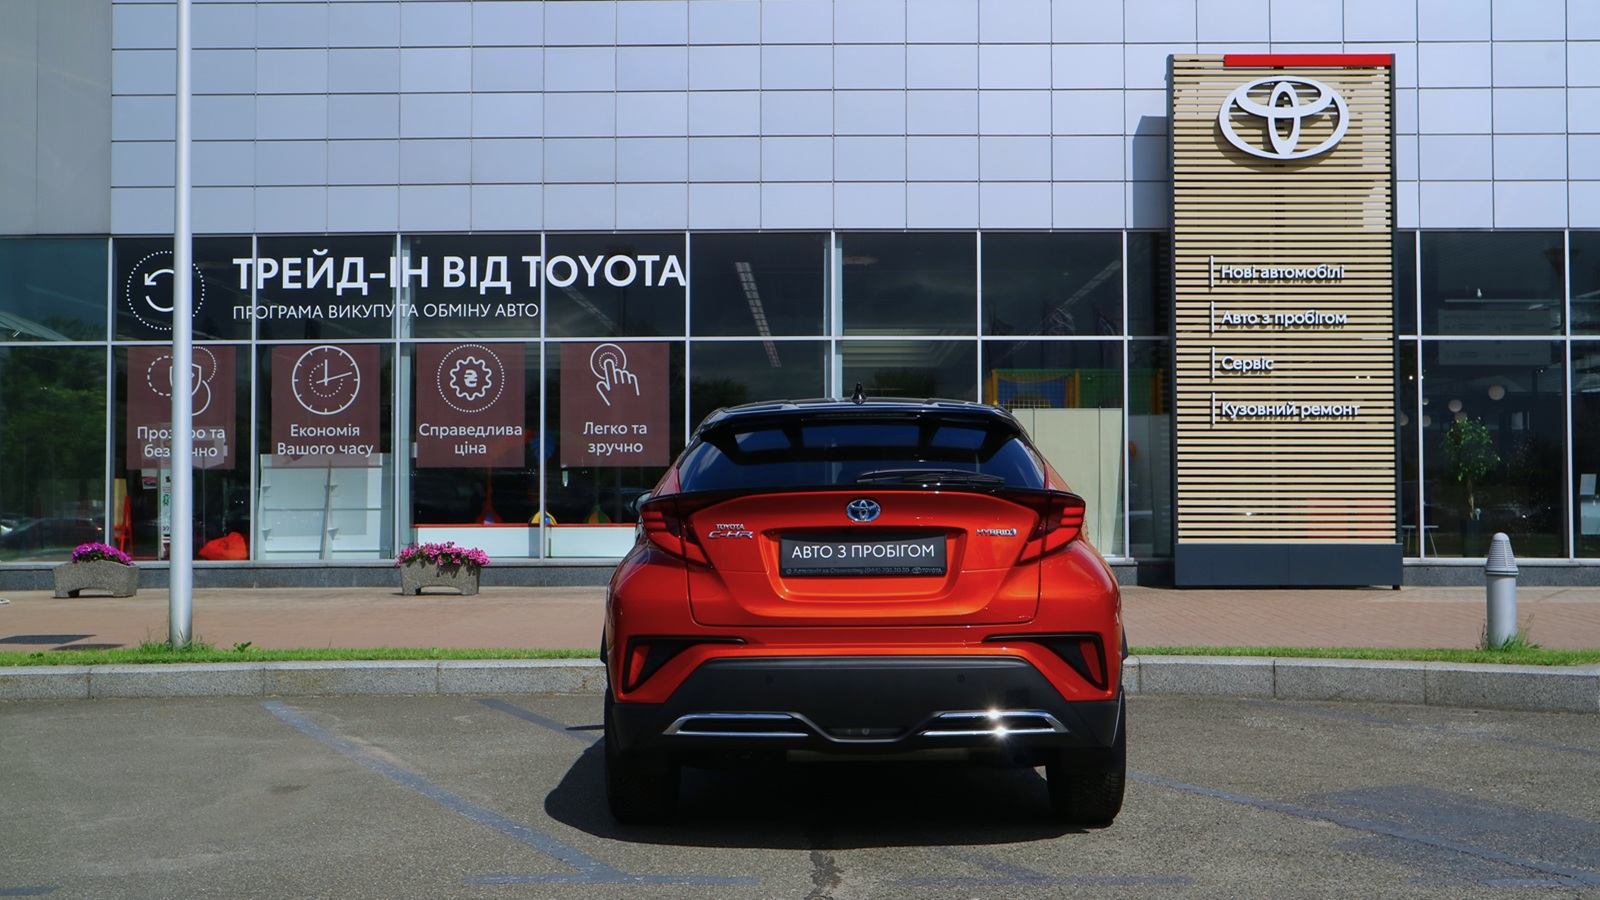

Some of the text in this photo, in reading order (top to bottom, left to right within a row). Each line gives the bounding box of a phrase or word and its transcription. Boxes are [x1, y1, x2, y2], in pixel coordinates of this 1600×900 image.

[232, 248, 686, 296] ТРЕЙД-ІН ВІД TOYOTA
[1221, 264, 1345, 279] Нові автомобілі
[233, 303, 540, 320] ПРОГРАМА ВИКУПУ ТА ОБМІНУ АВТО
[1221, 310, 1347, 327] Авто з пробігом
[1221, 356, 1275, 373] Сервіс
[1221, 401, 1361, 418] Кузовний ремонт
[210, 429, 225, 439] та
[290, 423, 360, 437] Економія
[419, 423, 523, 440] Справедлива
[583, 421, 648, 435] Легко та
[277, 442, 374, 459] Вашого часу
[454, 441, 487, 456] ціна
[587, 443, 644, 460] зручно
[708, 530, 754, 539] C-HR
[715, 523, 745, 531] TOYOTA
[791, 544, 935, 559] АВТО З ПРОБІГОМ
